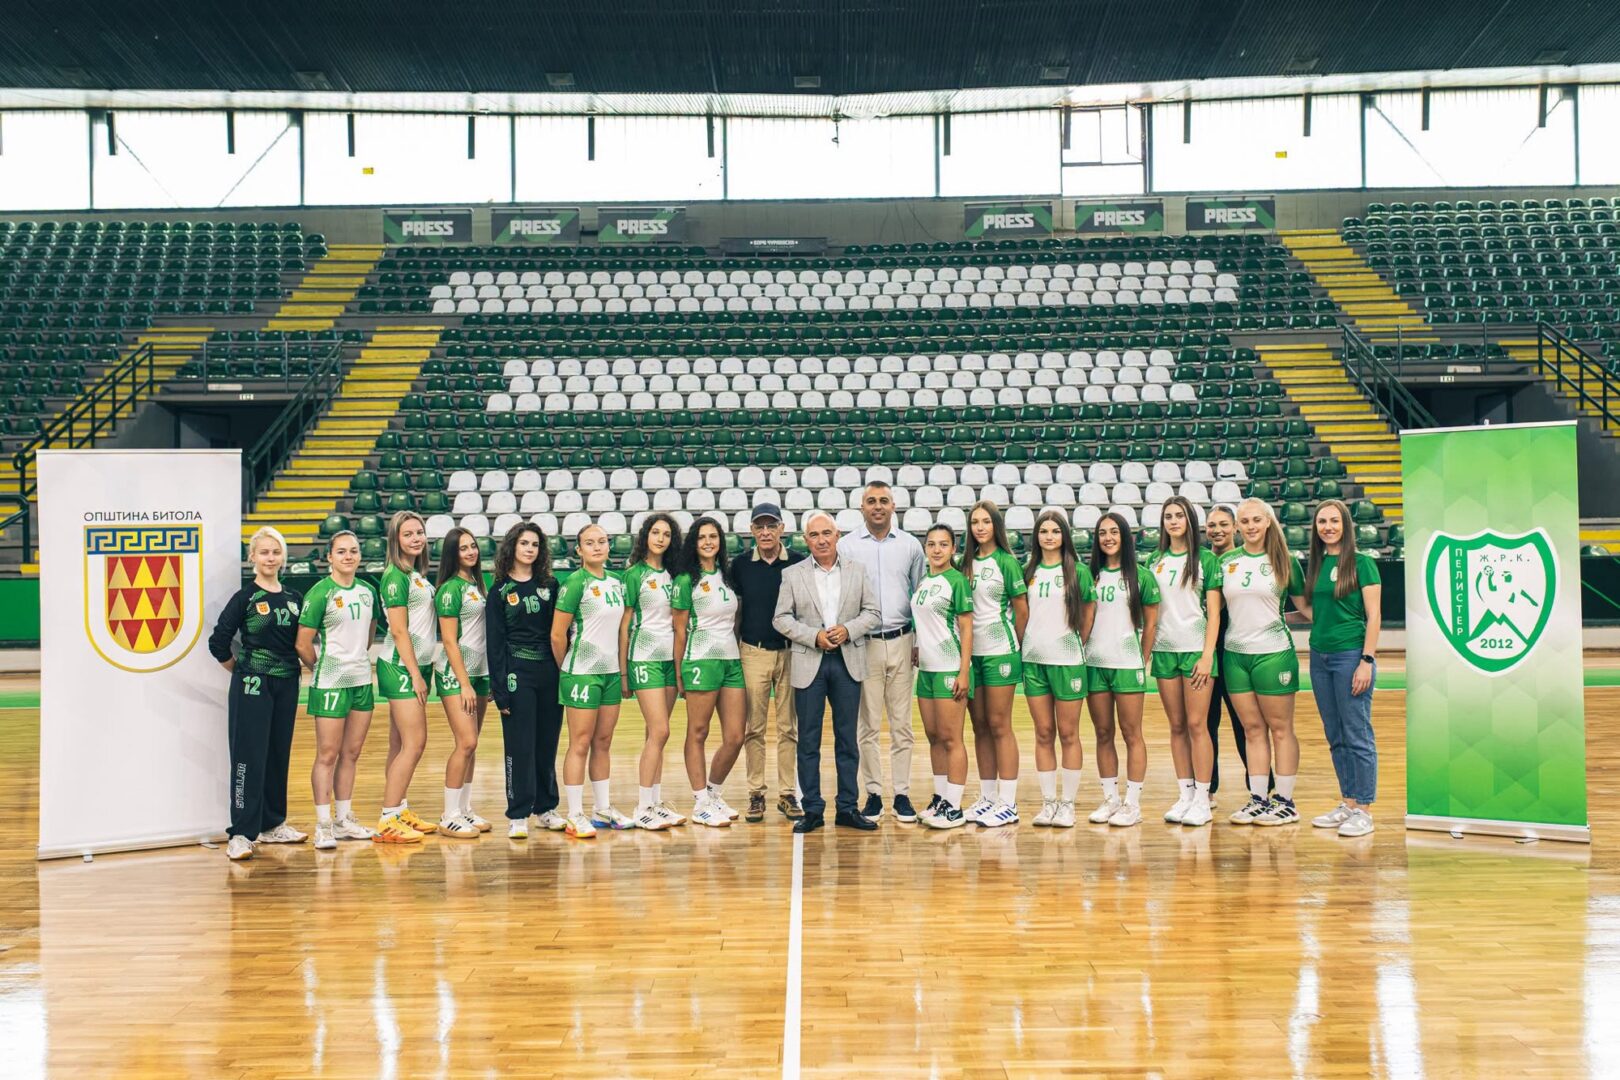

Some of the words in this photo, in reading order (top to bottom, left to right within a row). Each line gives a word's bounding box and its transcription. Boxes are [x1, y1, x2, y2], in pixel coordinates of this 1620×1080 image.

[983, 213, 1034, 229] PRESS
[1093, 210, 1145, 227] PRESS
[1204, 207, 1256, 224] PRESS
[402, 221, 454, 236] PRESS
[510, 220, 561, 235] PRESS
[617, 219, 668, 235] PRESS
[83, 511, 150, 522] ОПШТИНА
[152, 510, 203, 521] БИТОЛА
[1168, 570, 1178, 587] 7
[1241, 571, 1253, 588] 3
[718, 586, 730, 602] 2
[916, 589, 928, 606] 19
[1038, 581, 1051, 598] 11
[1100, 585, 1115, 603] 18
[1455, 548, 1464, 636] ПЕЛИСТЕР
[523, 595, 541, 614] 16
[604, 590, 621, 608] 44
[273, 607, 292, 627] 12
[347, 602, 360, 621] 17
[1480, 638, 1513, 649] 2012
[634, 665, 649, 685] 15
[692, 666, 701, 685] 2
[242, 675, 262, 696] 12
[570, 683, 590, 703] 44
[323, 691, 340, 712] 17
[235, 762, 247, 809] STELLAR
